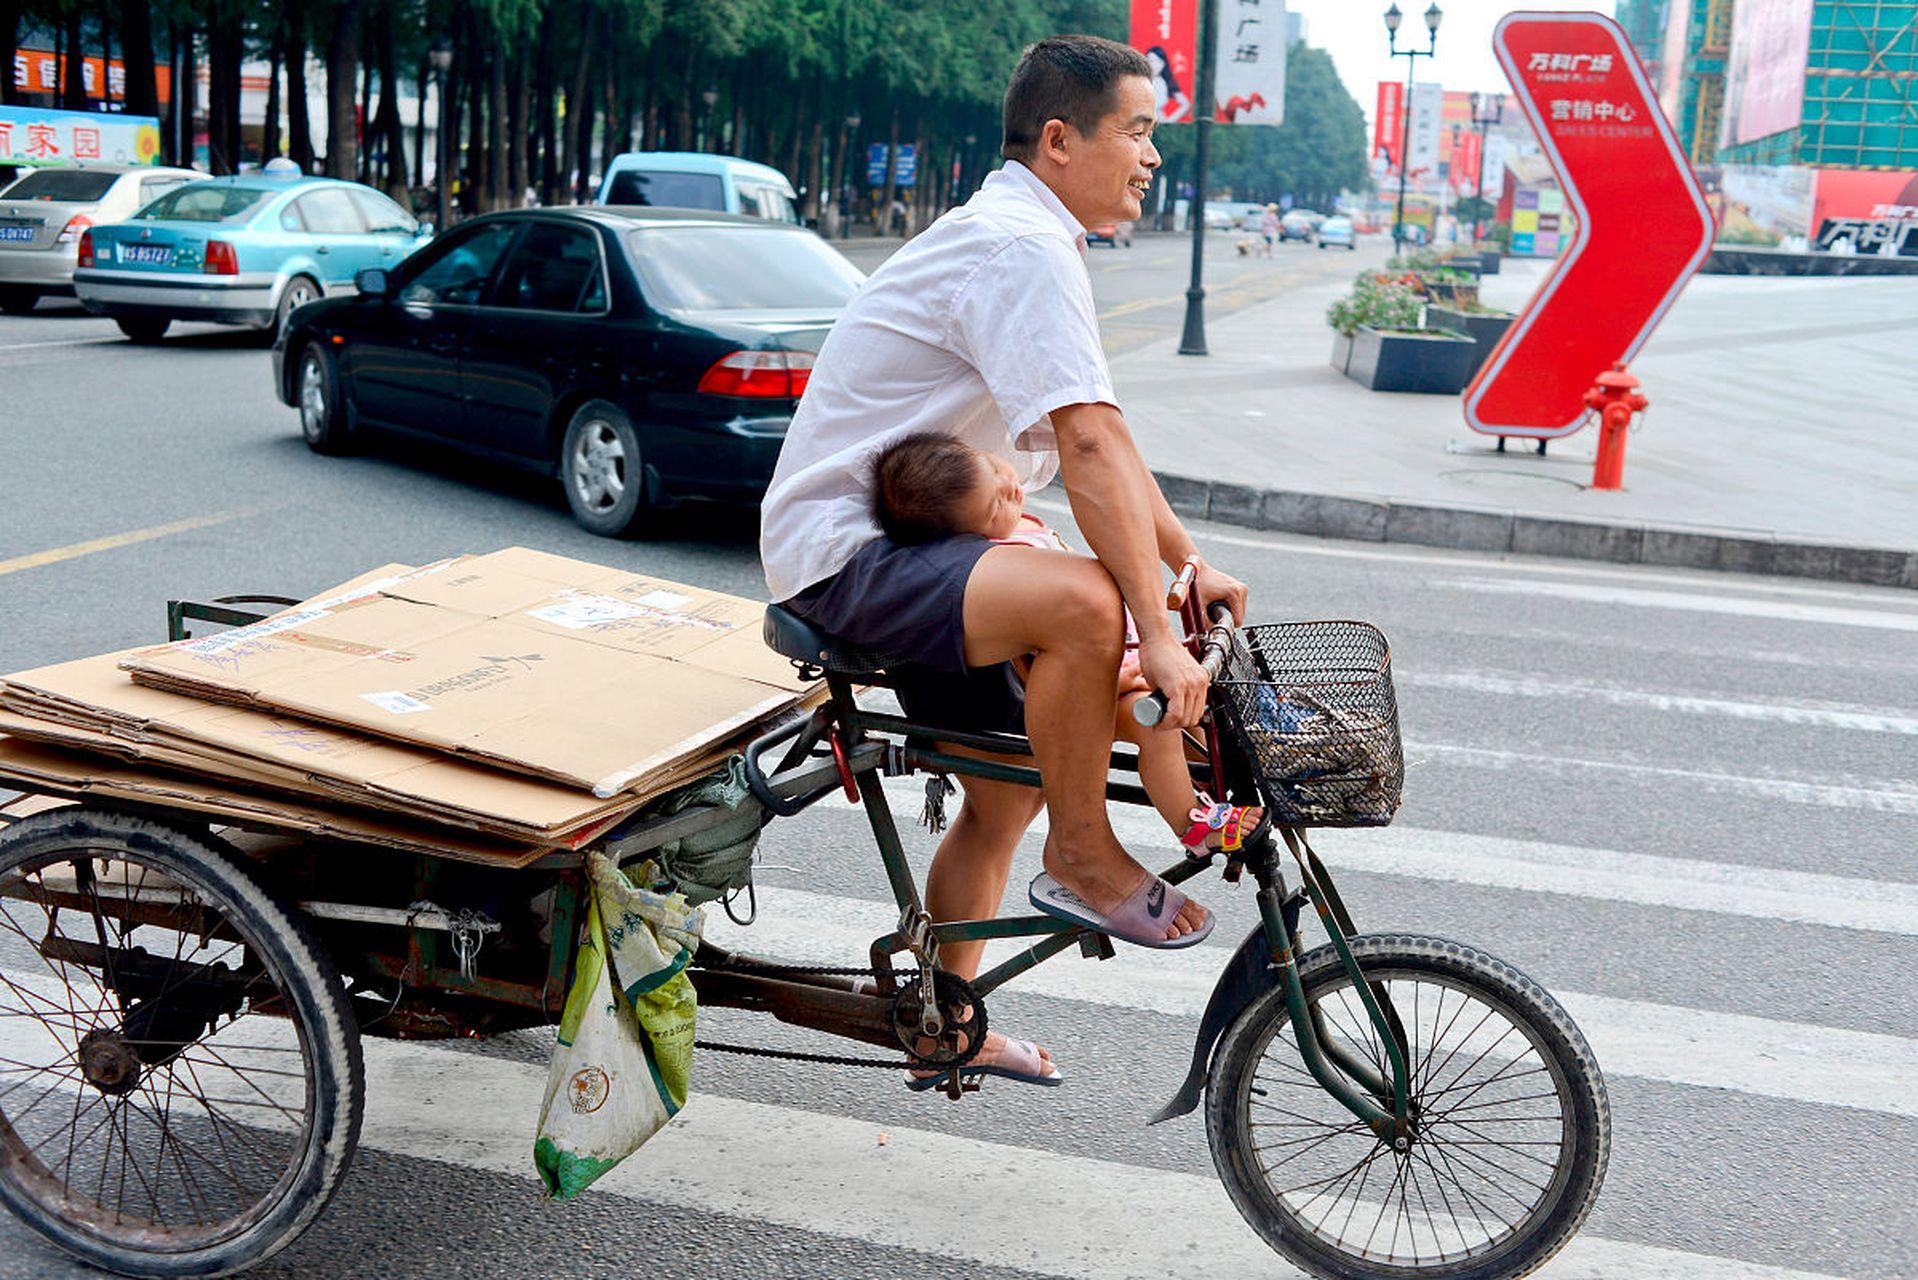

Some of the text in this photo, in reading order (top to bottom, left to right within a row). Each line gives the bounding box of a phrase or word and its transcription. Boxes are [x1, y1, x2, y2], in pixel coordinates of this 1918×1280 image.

[1527, 53, 1613, 71] 万科广场
[1550, 100, 1636, 122] 营销中心
